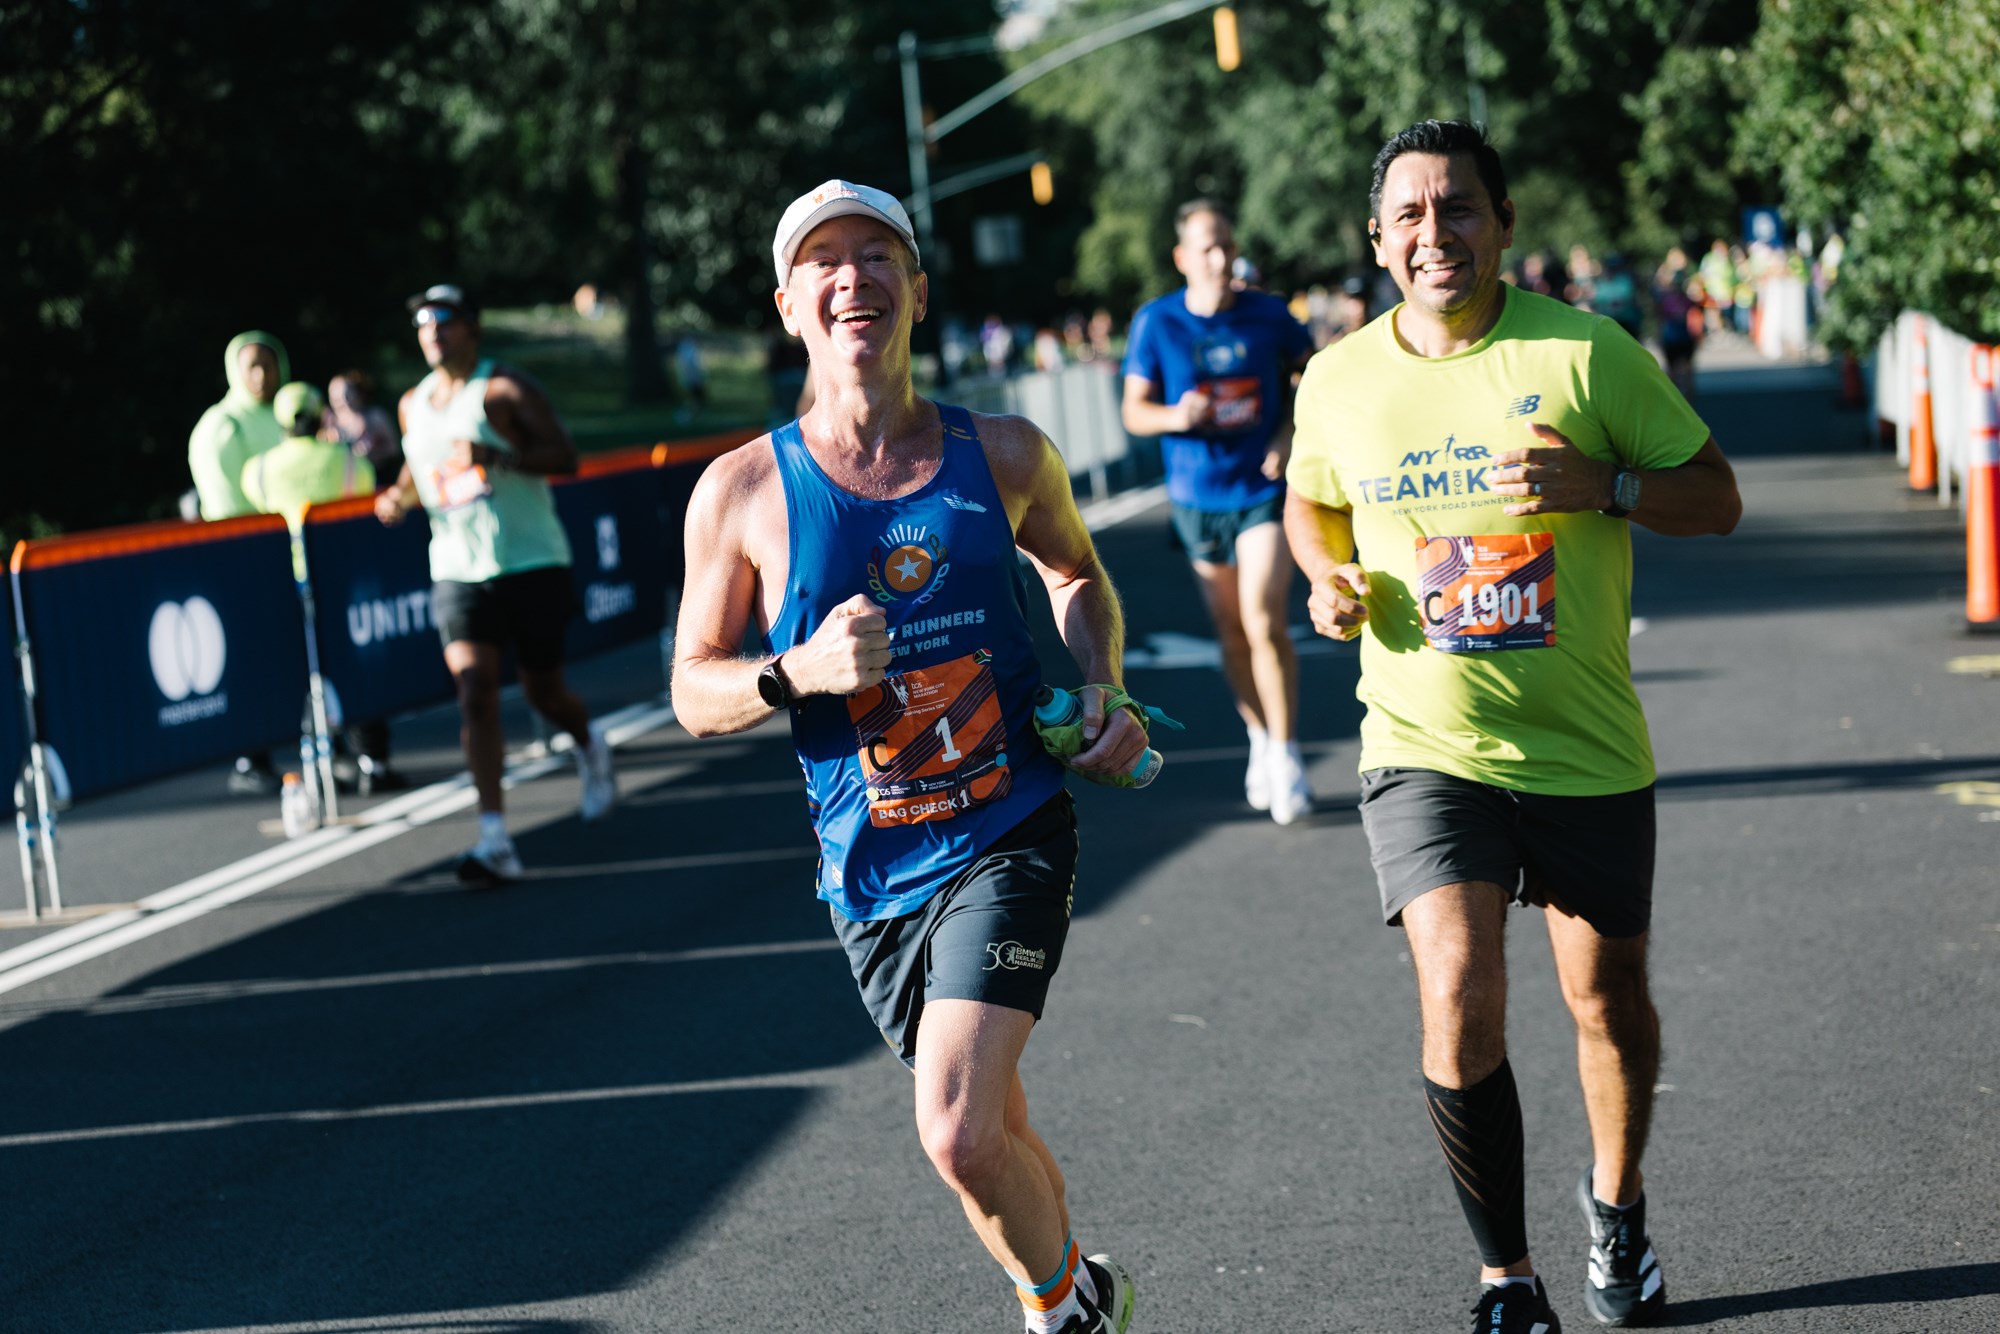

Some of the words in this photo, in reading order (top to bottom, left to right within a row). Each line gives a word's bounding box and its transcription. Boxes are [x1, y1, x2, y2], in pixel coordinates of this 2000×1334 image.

[1358, 471, 1450, 504] TEAM
[1453, 470, 1463, 495] FOR
[1415, 505, 1439, 514] YORK
[1441, 502, 1468, 511] ROAD
[1471, 496, 1516, 508] RUNNERS
[348, 591, 439, 646] UNIT
[1424, 590, 1446, 627] C
[1457, 582, 1542, 627] 1901
[901, 609, 986, 639] RUNNERS
[888, 644, 911, 658] EW
[914, 634, 951, 654] YORK
[913, 689, 938, 698] MARATHON
[921, 705, 936, 713] Series
[867, 736, 895, 773] C
[935, 716, 962, 763] 1
[878, 807, 907, 820] BAG
[909, 797, 958, 815] CHECK
[959, 789, 970, 809] 1
[982, 940, 1023, 970] 50
[1016, 947, 1037, 957] BMW
